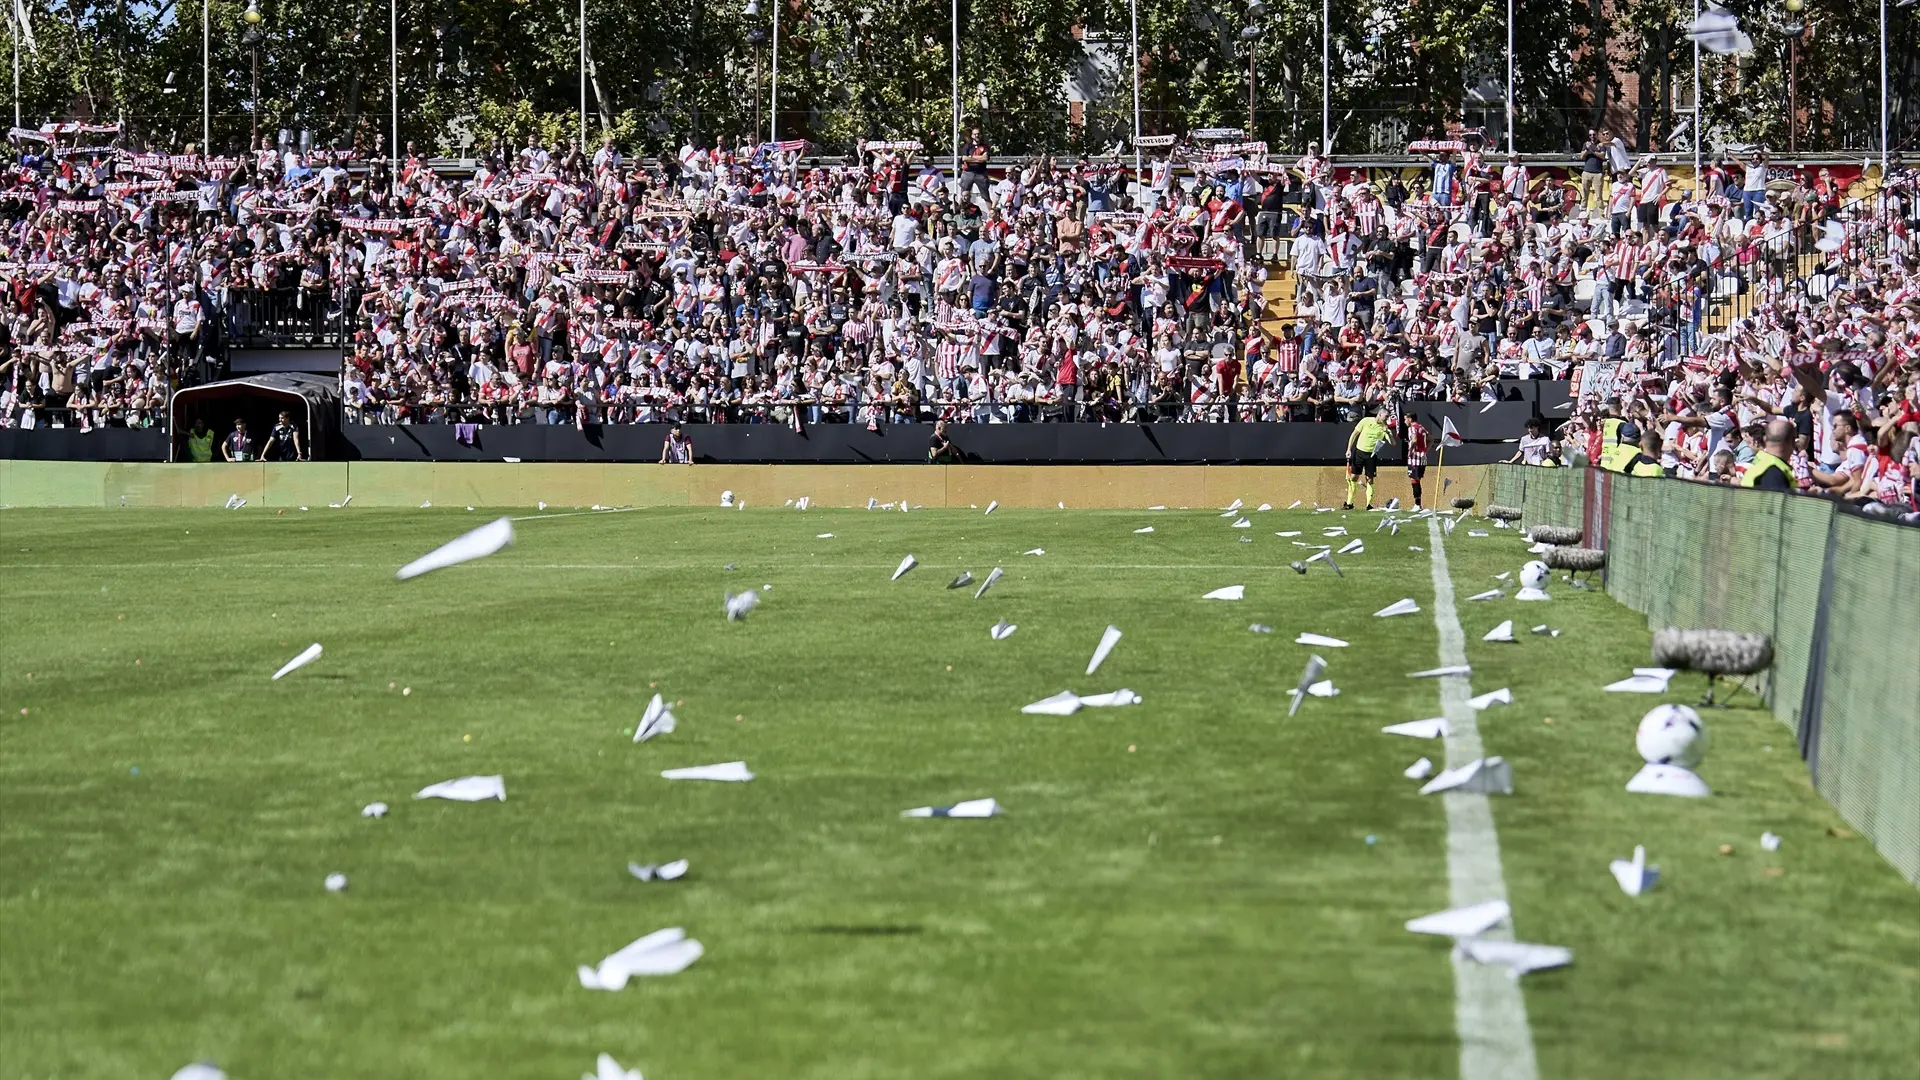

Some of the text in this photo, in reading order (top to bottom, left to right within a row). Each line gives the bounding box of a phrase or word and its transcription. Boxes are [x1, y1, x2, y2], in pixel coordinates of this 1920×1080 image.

[135, 157, 159, 166] PRESA
[152, 191, 178, 200] ORKING
[373, 220, 391, 230] VETE
